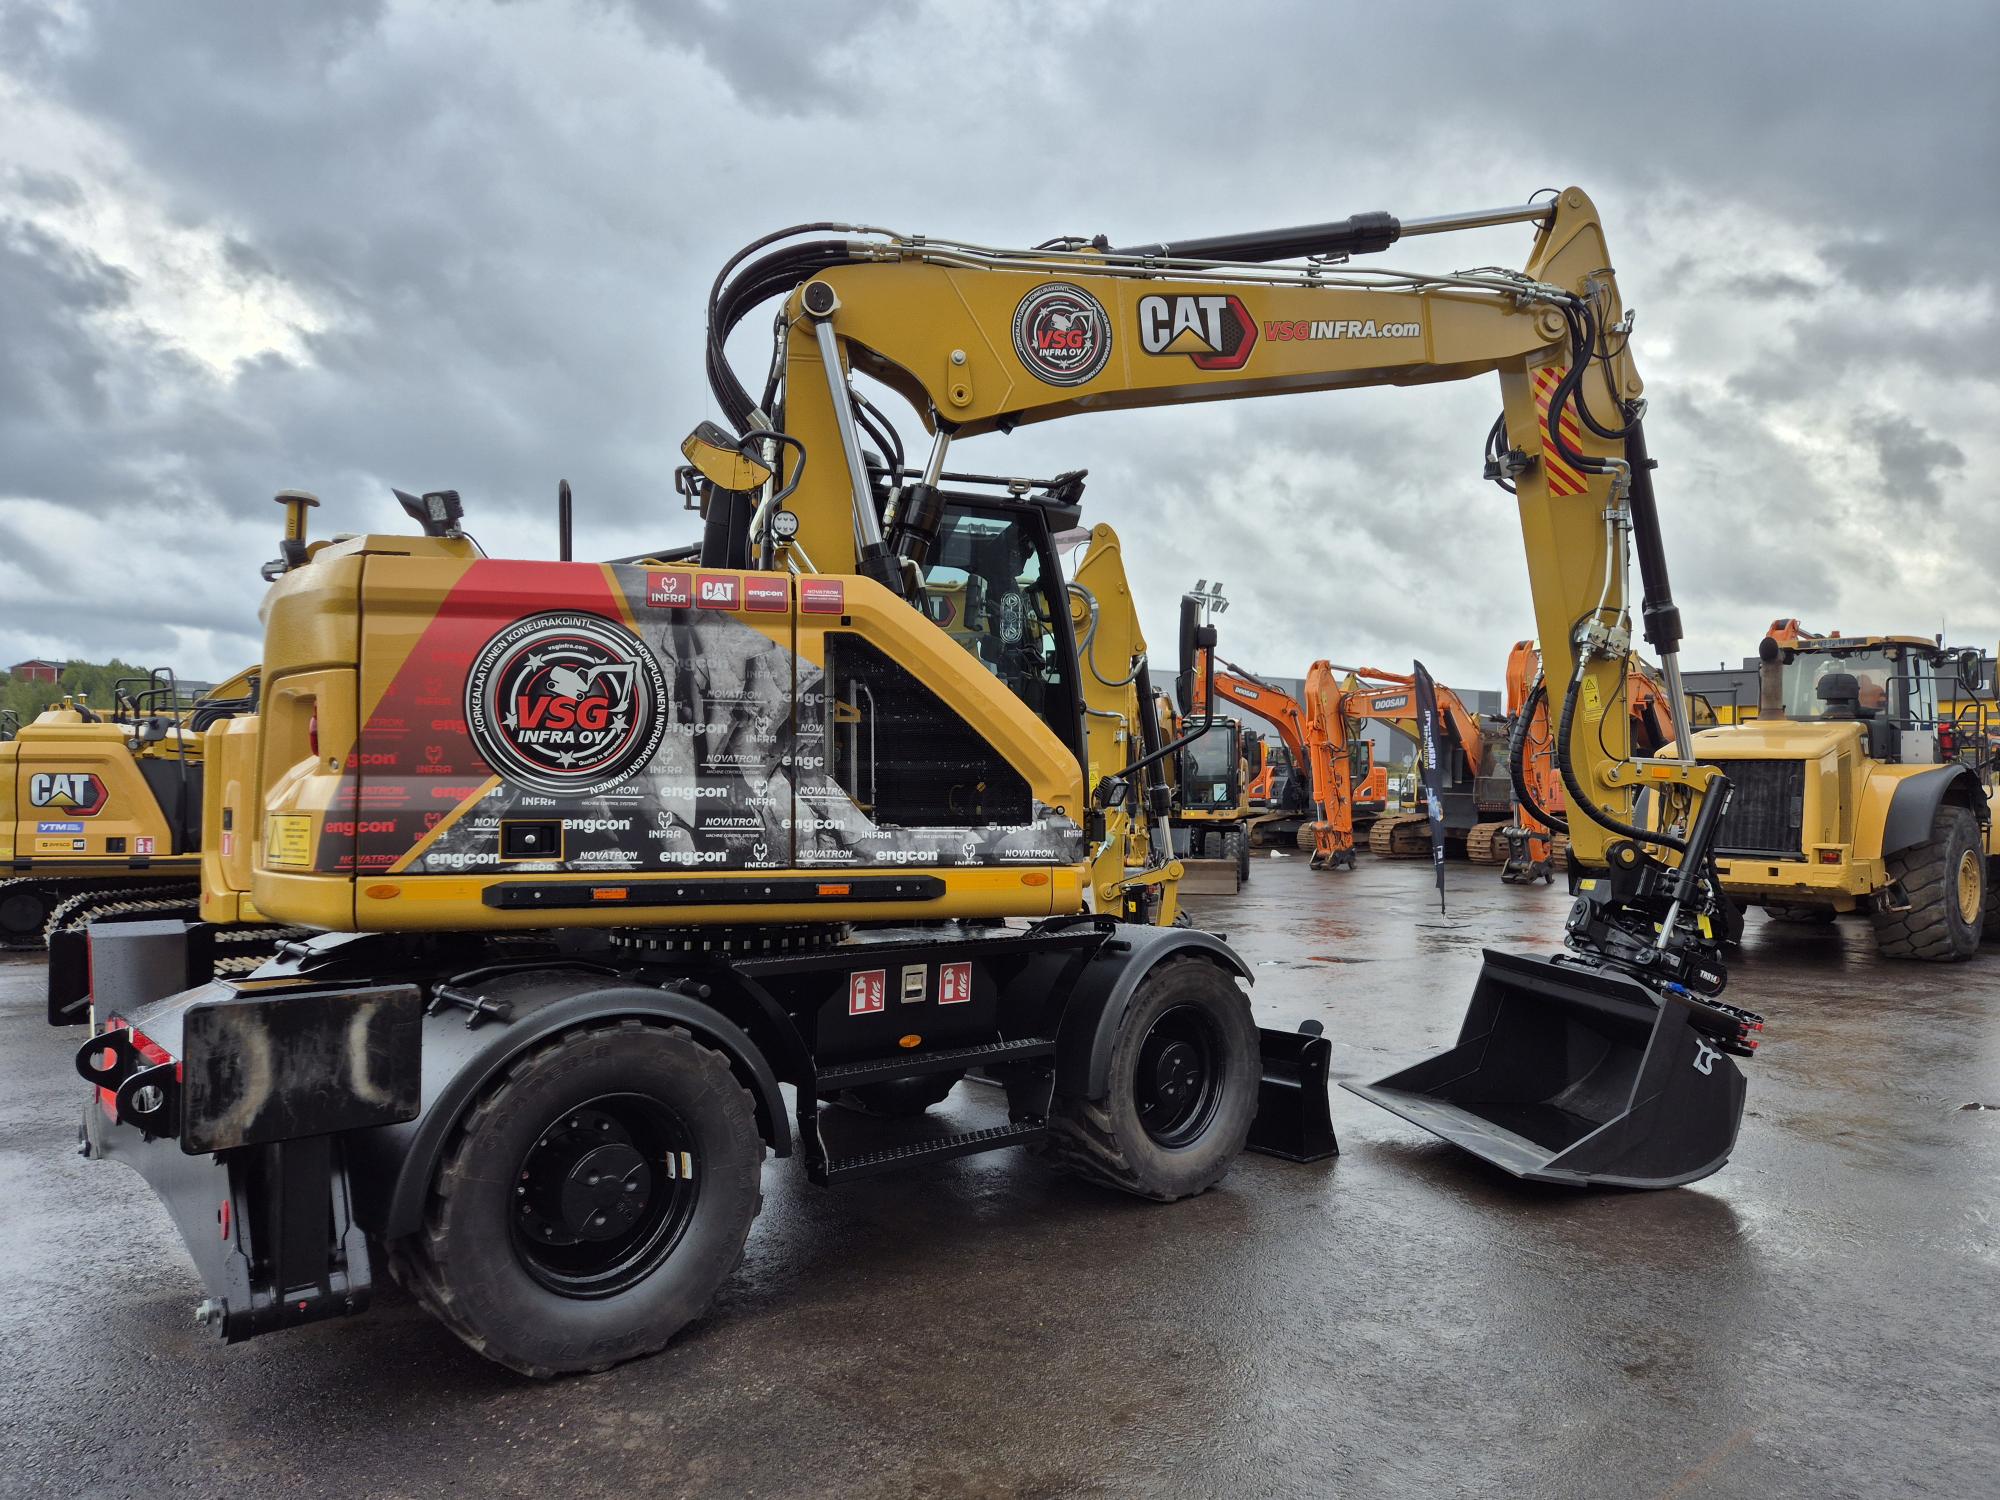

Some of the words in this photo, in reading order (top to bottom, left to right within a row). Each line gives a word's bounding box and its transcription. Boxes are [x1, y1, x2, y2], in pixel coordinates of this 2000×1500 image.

[1140, 296, 1227, 352] CAT
[1264, 320, 1421, 341] VSGINFRA.com
[1037, 330, 1083, 349] VSG
[1040, 348, 1067, 357] INFRA
[1069, 348, 1082, 357] OY
[702, 581, 734, 601] CAT
[748, 589, 783, 598] engcon
[651, 593, 686, 603] INFRA
[473, 641, 508, 733] KORKEALAATUINEN
[506, 617, 591, 643] KONEURAKOINTI
[632, 640, 666, 712] MONIPUOLINEN
[1375, 697, 1406, 710] DOOSAN
[517, 696, 609, 730] VSG
[665, 723, 728, 736] engcon
[517, 731, 575, 744] INFRA
[578, 730, 606, 744] OY
[745, 735, 777, 744] INFRA
[589, 713, 666, 795] INFRARAKENTAMINEN
[706, 754, 761, 763] NOVATRON
[416, 765, 452, 773] INFRA
[650, 766, 682, 774] INFRA
[31, 773, 90, 806] CAT
[660, 785, 728, 800] engcon
[521, 797, 556, 806] INFRA
[745, 798, 776, 806] INFRA
[40, 823, 67, 831] YTM
[325, 821, 397, 836] engcon
[562, 818, 631, 833] engcon
[705, 818, 761, 826] NOVATRON
[781, 818, 845, 833] engcon
[649, 830, 681, 838] INFRA
[862, 832, 891, 840] INFRA
[580, 851, 638, 860] NOVATRON
[659, 850, 728, 866] engcon
[799, 850, 852, 858] NOVATRON
[876, 850, 939, 865] engcon
[1005, 849, 1054, 858] NOVATRON
[426, 853, 501, 868] engcon
